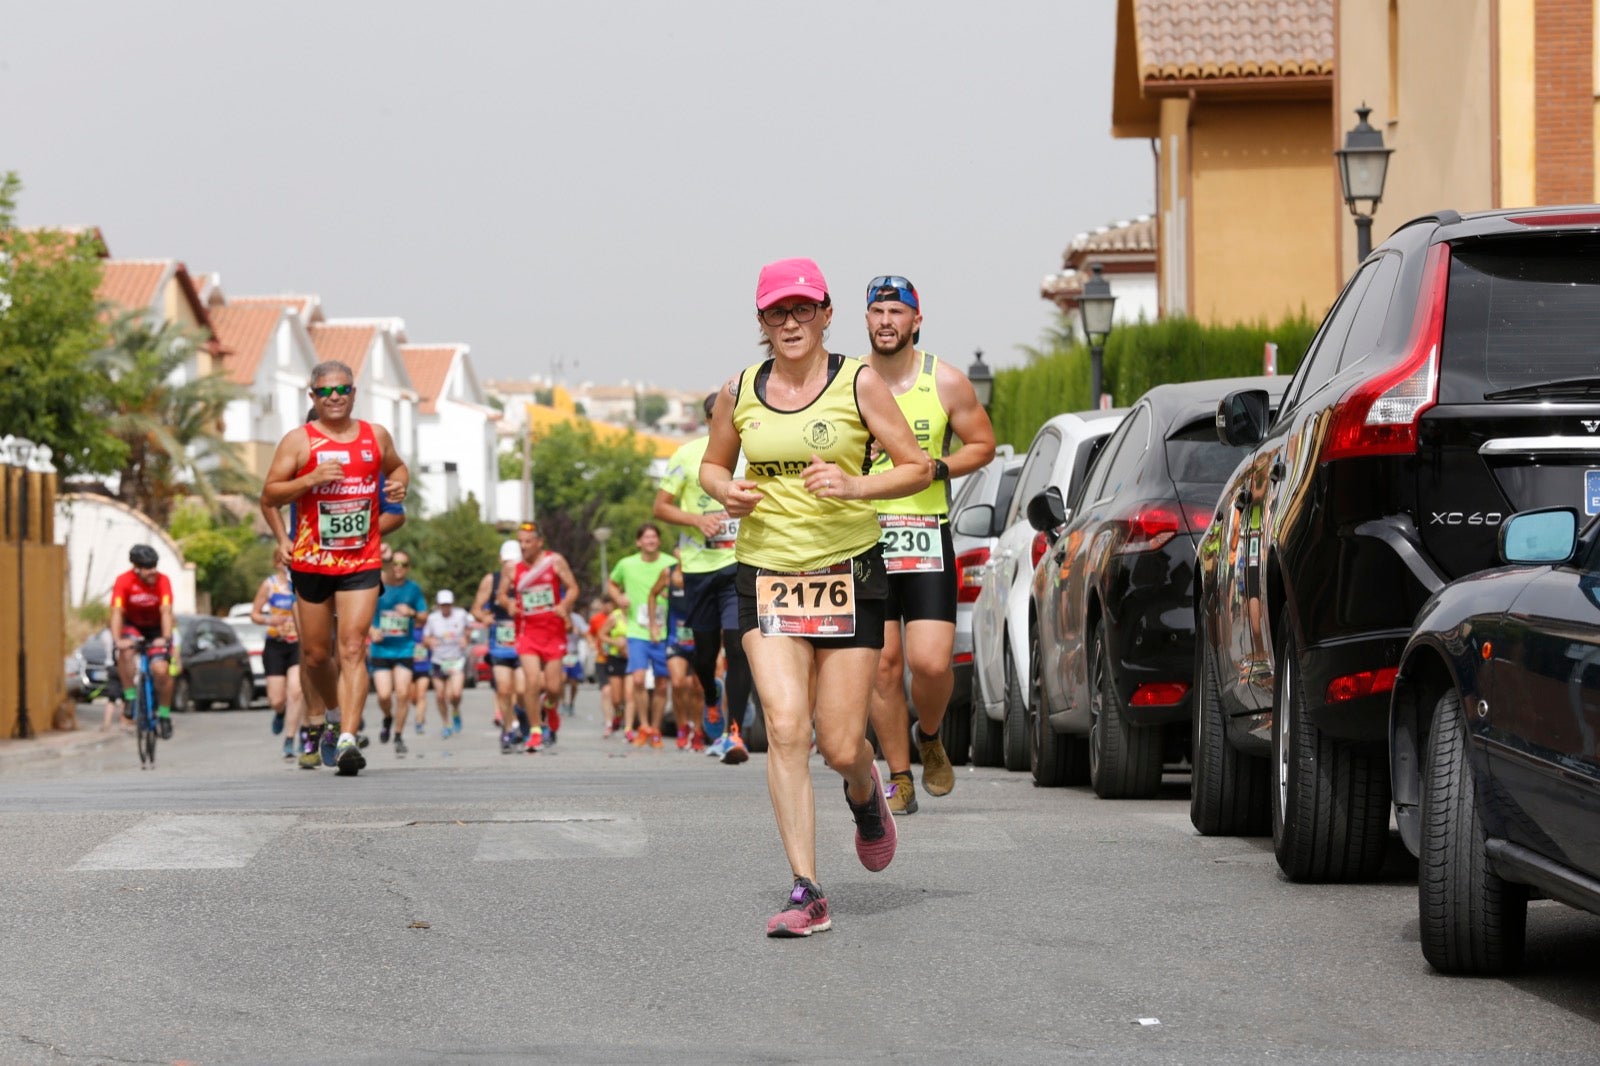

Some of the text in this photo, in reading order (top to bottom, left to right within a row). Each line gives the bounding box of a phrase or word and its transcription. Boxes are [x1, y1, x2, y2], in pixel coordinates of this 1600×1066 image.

[330, 514, 365, 534] 588
[884, 530, 931, 552] 230
[770, 580, 848, 609] 2176
